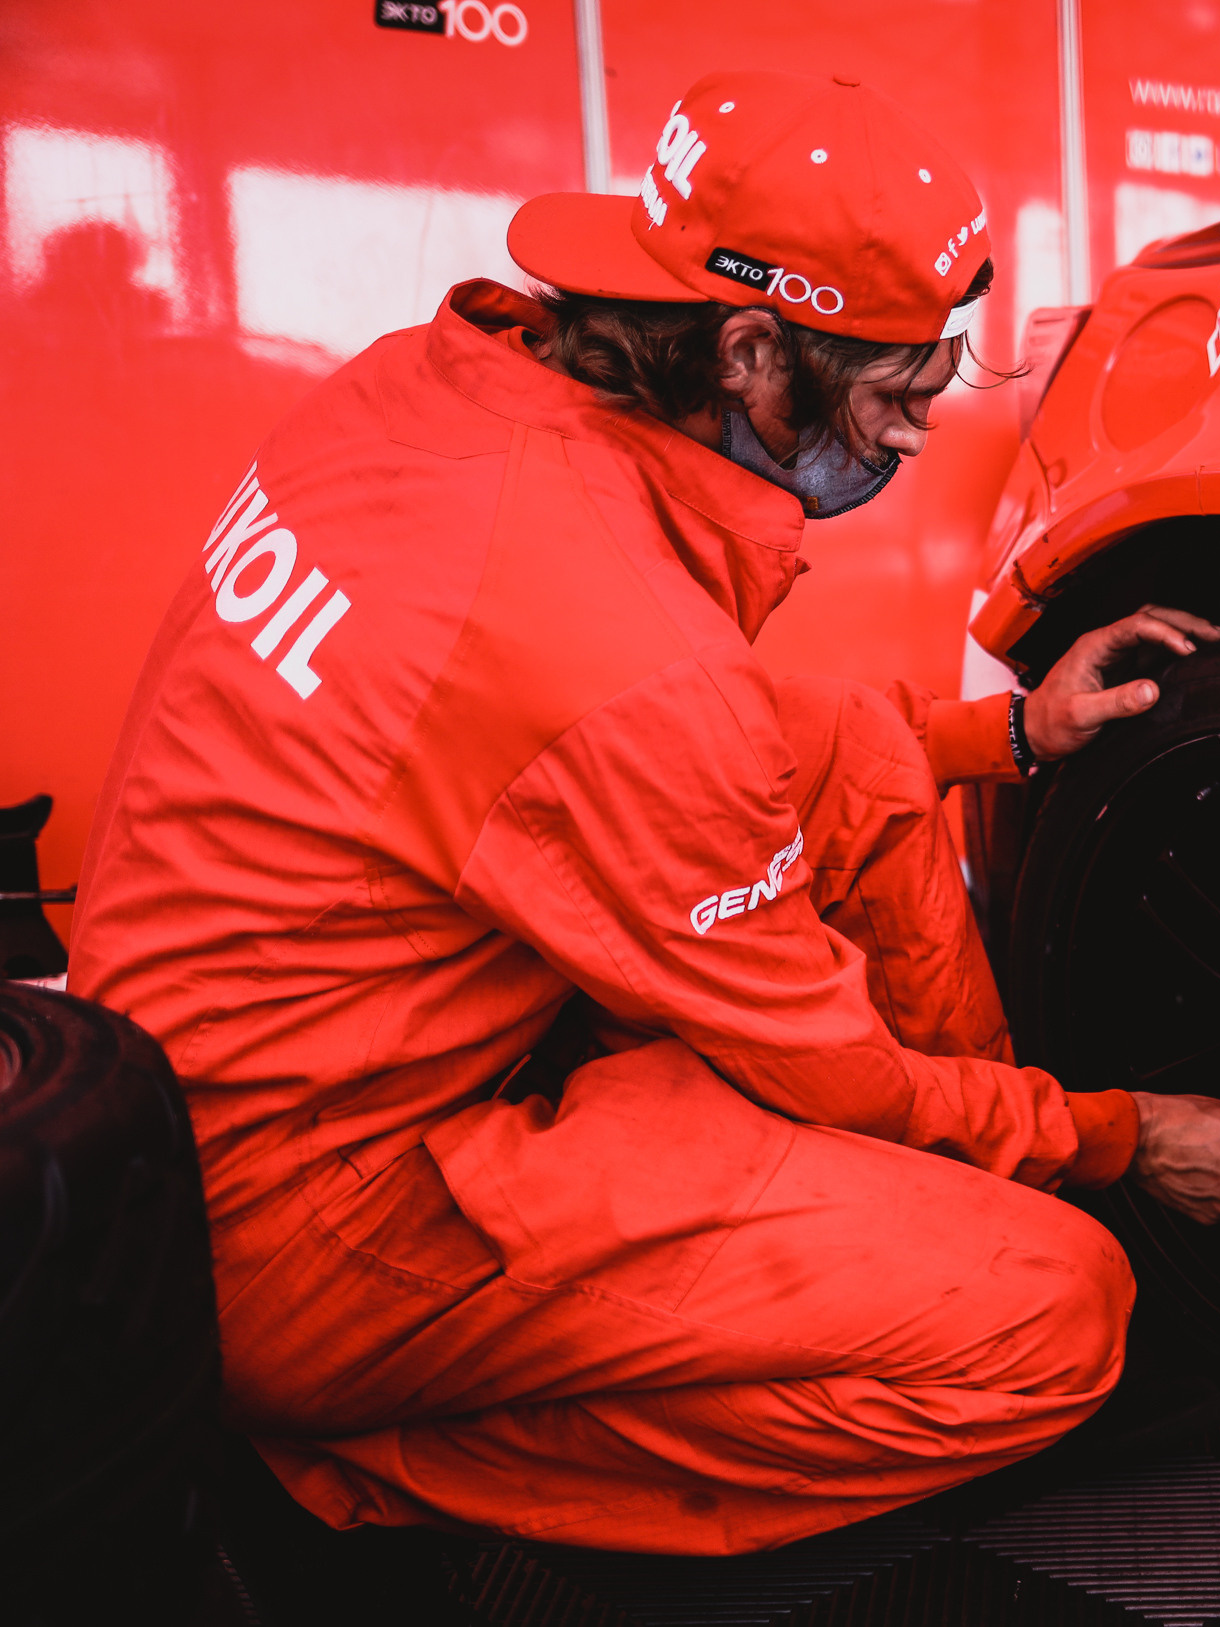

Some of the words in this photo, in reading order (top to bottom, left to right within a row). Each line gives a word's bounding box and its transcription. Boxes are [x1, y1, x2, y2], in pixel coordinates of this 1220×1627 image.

[439, 0, 528, 47] 100
[656, 99, 707, 200] OIL
[715, 255, 764, 281] ЭКТО
[766, 267, 844, 315] 100
[202, 460, 352, 700] UKOIL
